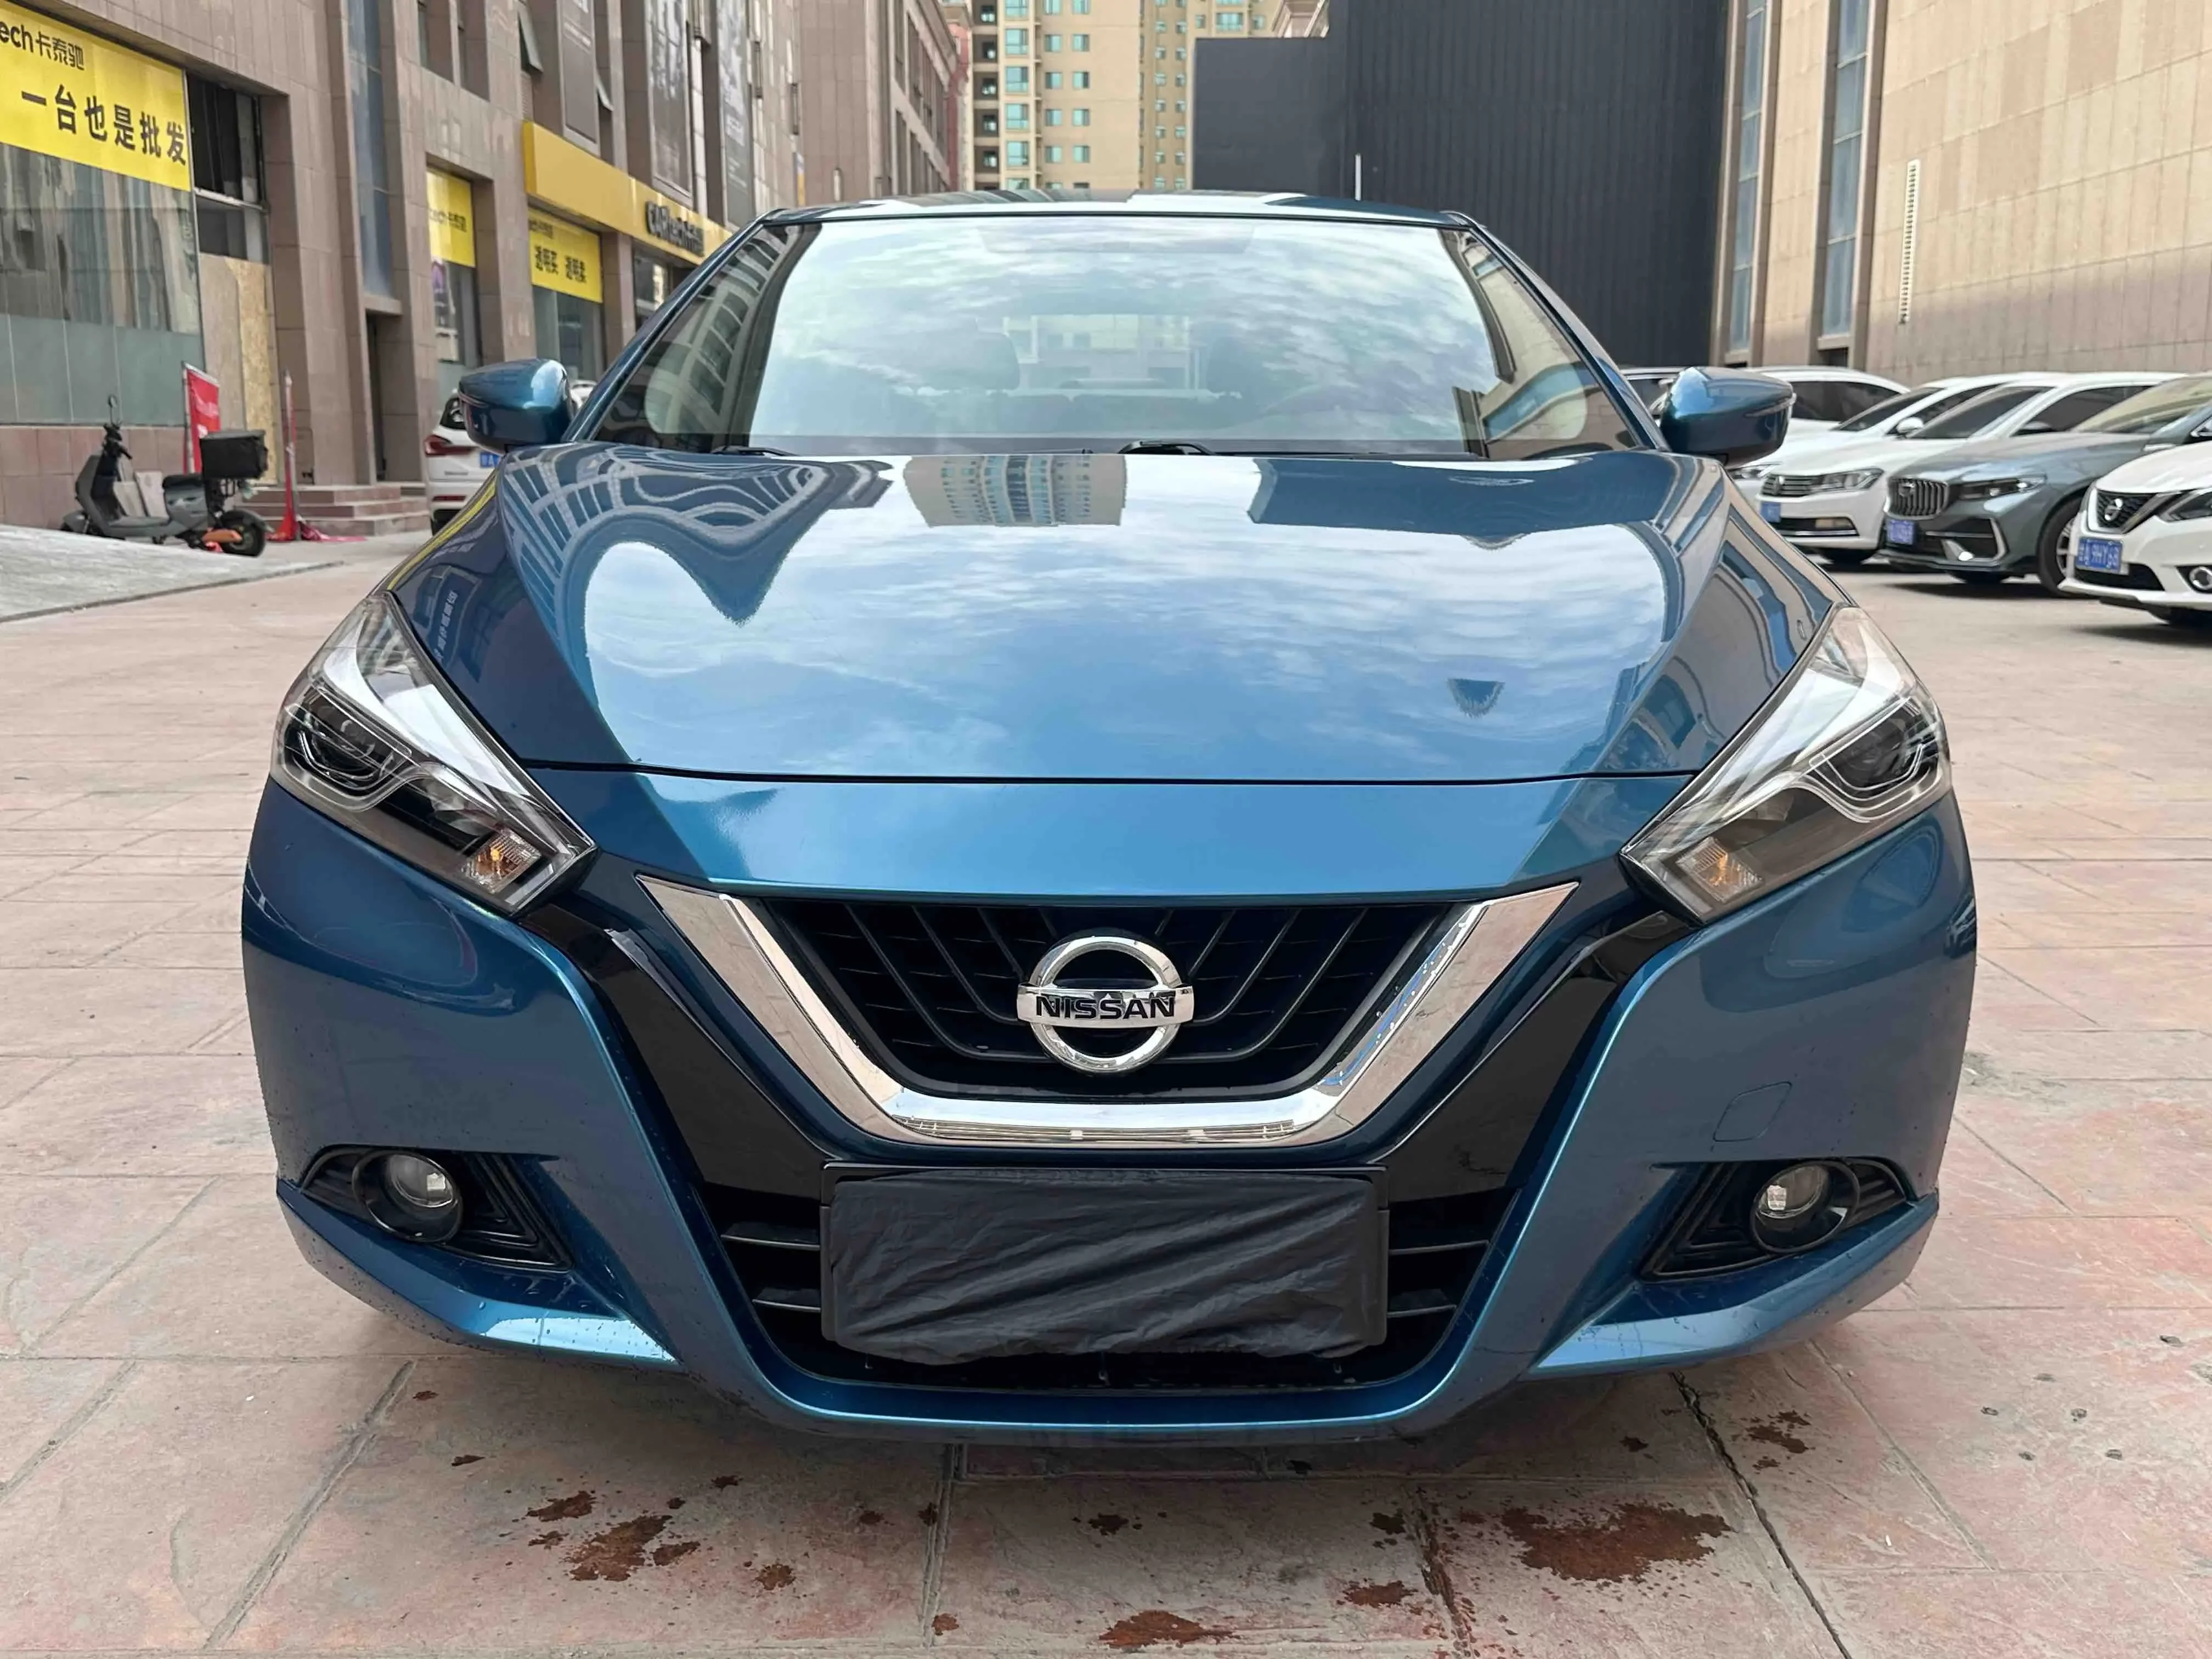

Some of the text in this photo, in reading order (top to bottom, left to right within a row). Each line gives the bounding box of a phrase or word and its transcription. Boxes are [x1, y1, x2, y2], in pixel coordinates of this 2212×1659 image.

[21, 84, 186, 166] 一台也是批发
[1036, 994, 1175, 1019] NISSAN
